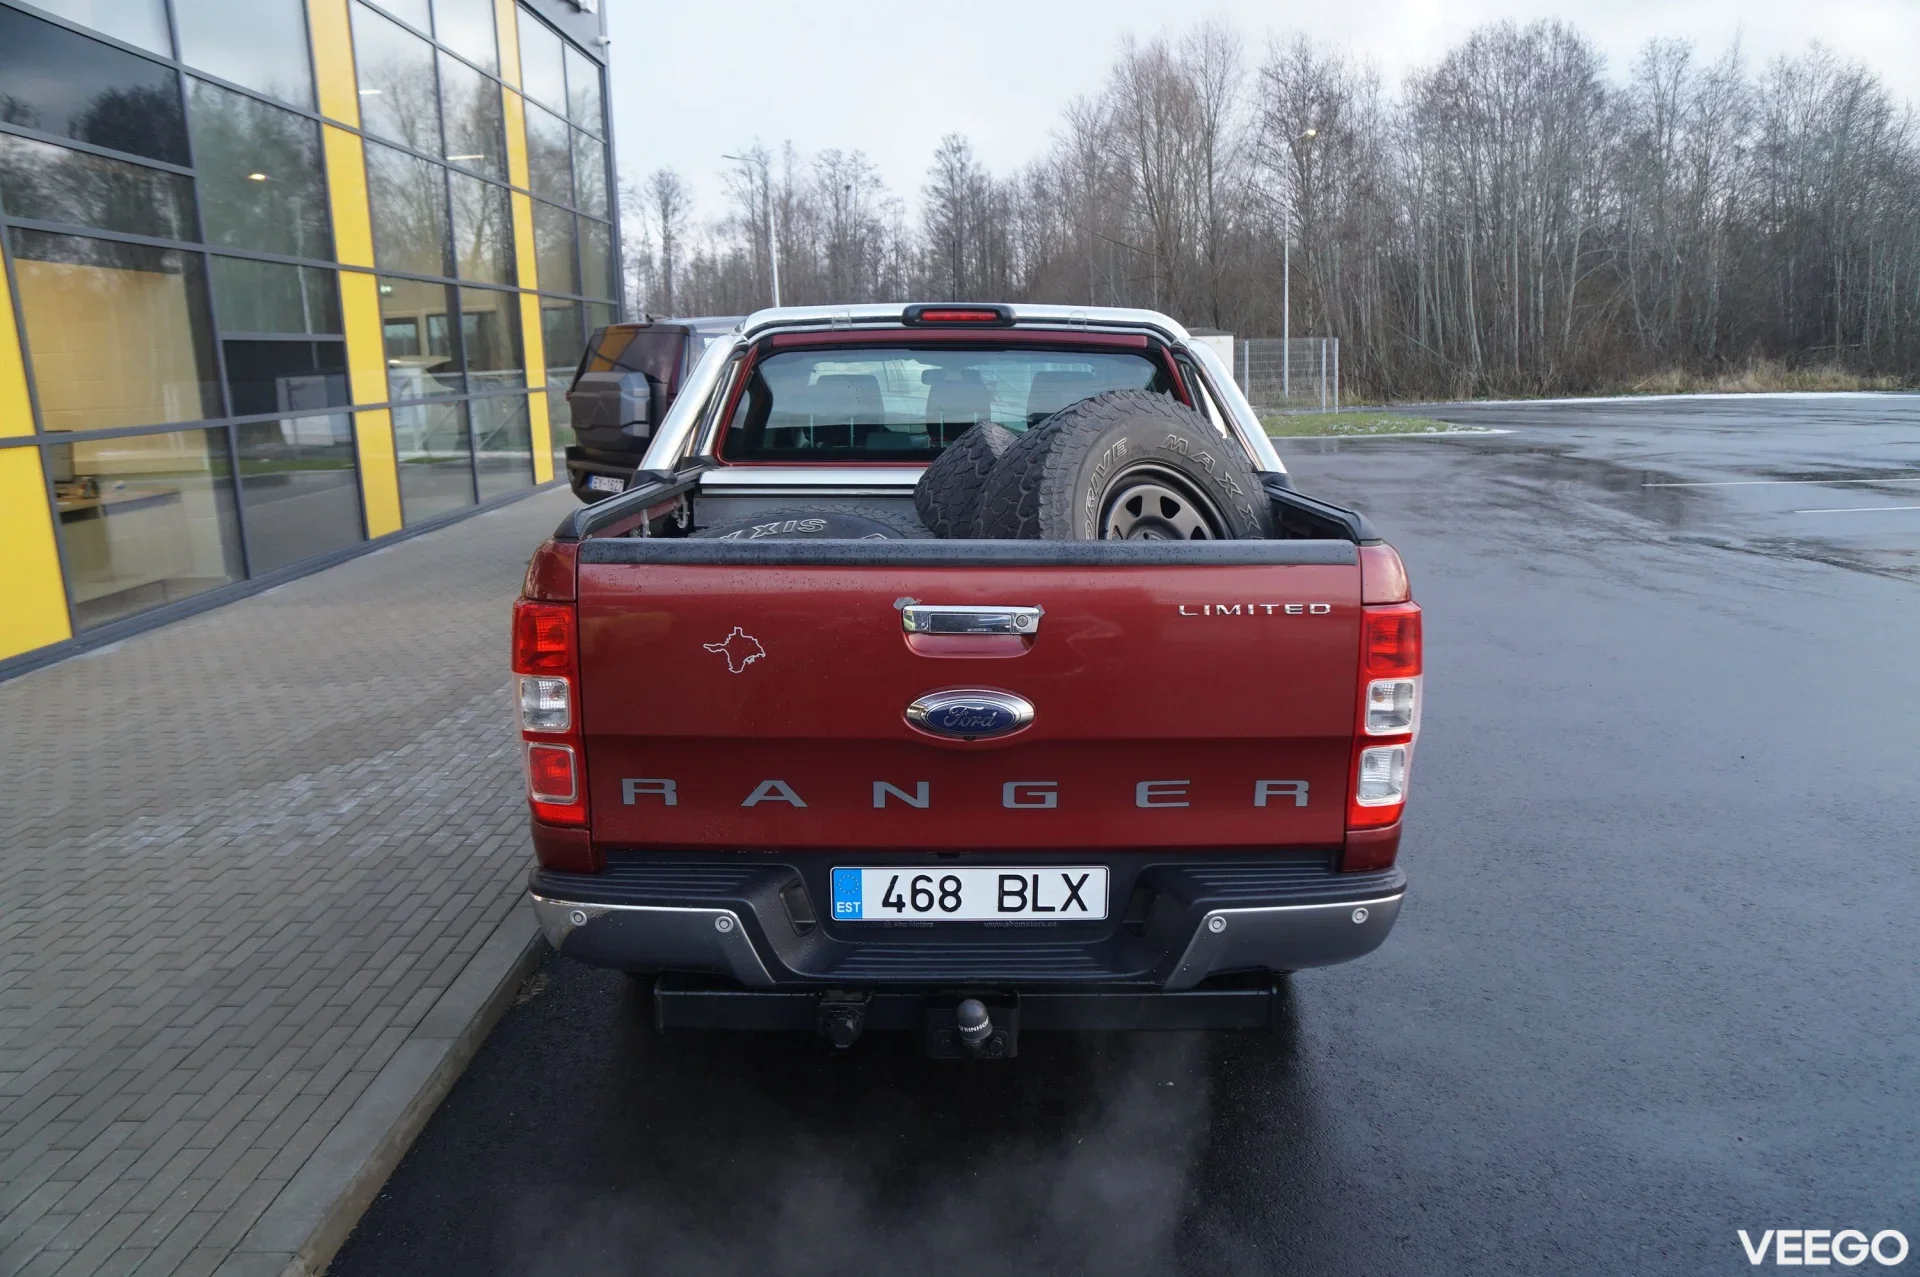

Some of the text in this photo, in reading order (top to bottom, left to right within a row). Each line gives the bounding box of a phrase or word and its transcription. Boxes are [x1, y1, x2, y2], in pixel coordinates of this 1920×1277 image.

[1158, 433, 1264, 540] MAXX
[1178, 603, 1331, 616] LIMITED
[943, 705, 997, 727] Ford
[620, 777, 1310, 809] RANGER
[881, 873, 1090, 913] 468 BLX
[836, 901, 862, 913] EST
